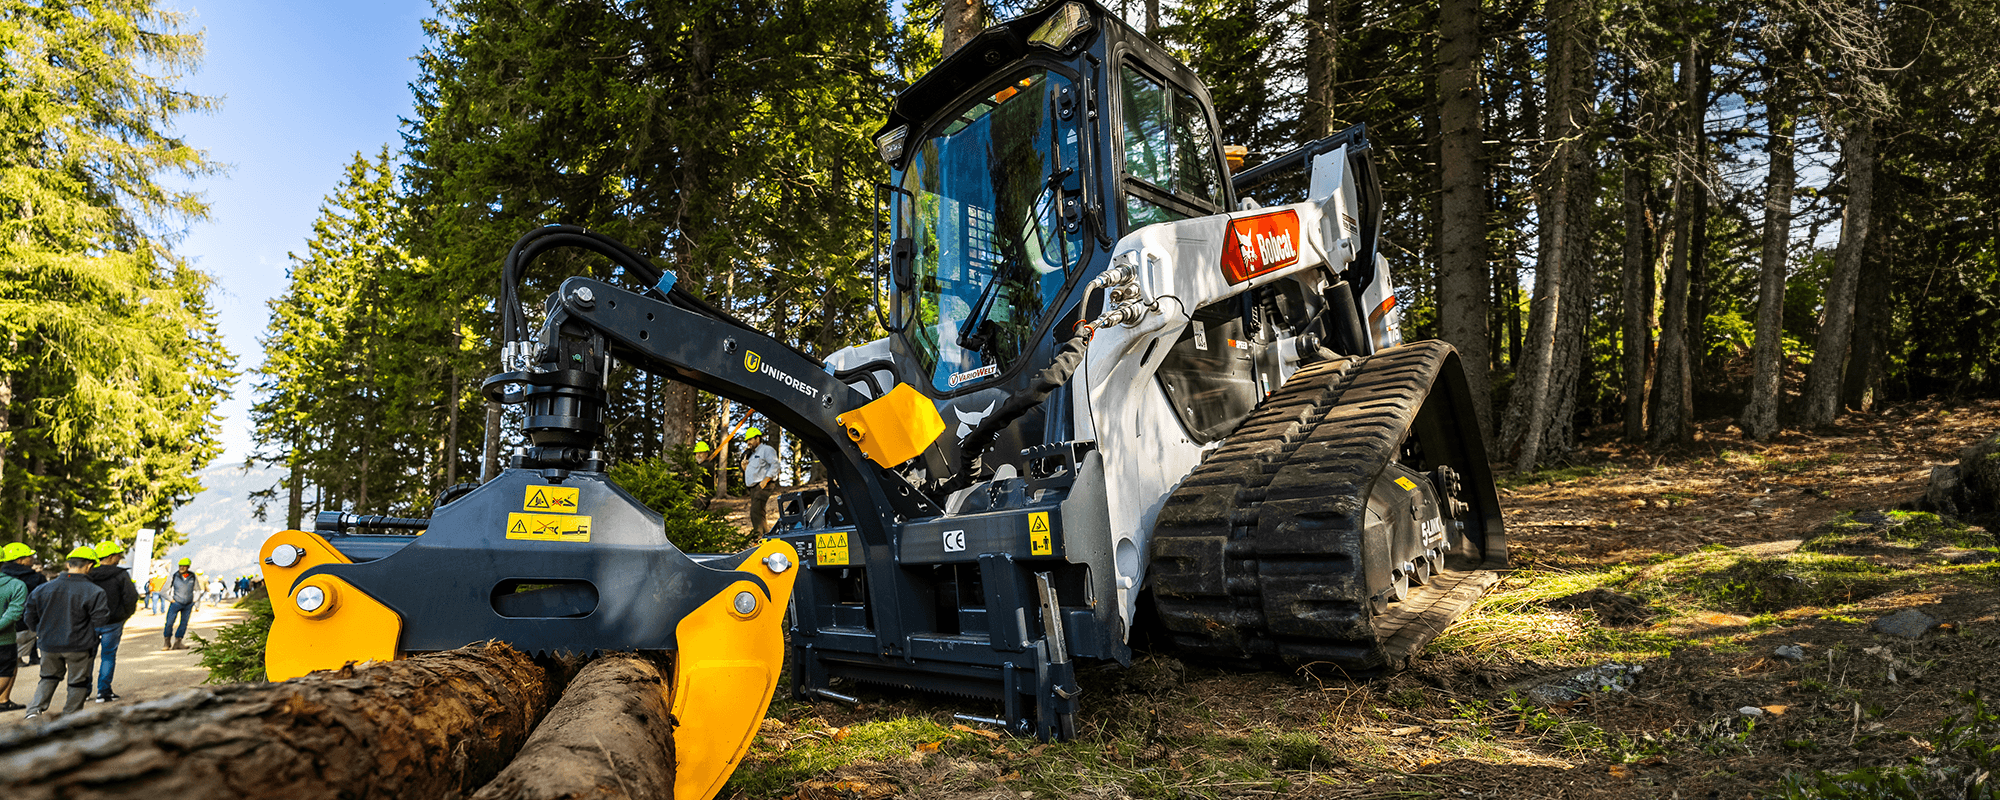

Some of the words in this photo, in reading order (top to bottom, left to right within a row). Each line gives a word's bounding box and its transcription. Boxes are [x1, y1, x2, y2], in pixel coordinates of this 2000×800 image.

[1256, 228, 1297, 265] Bobcat
[760, 361, 819, 398] UNIFOREST
[945, 531, 965, 550] CE
